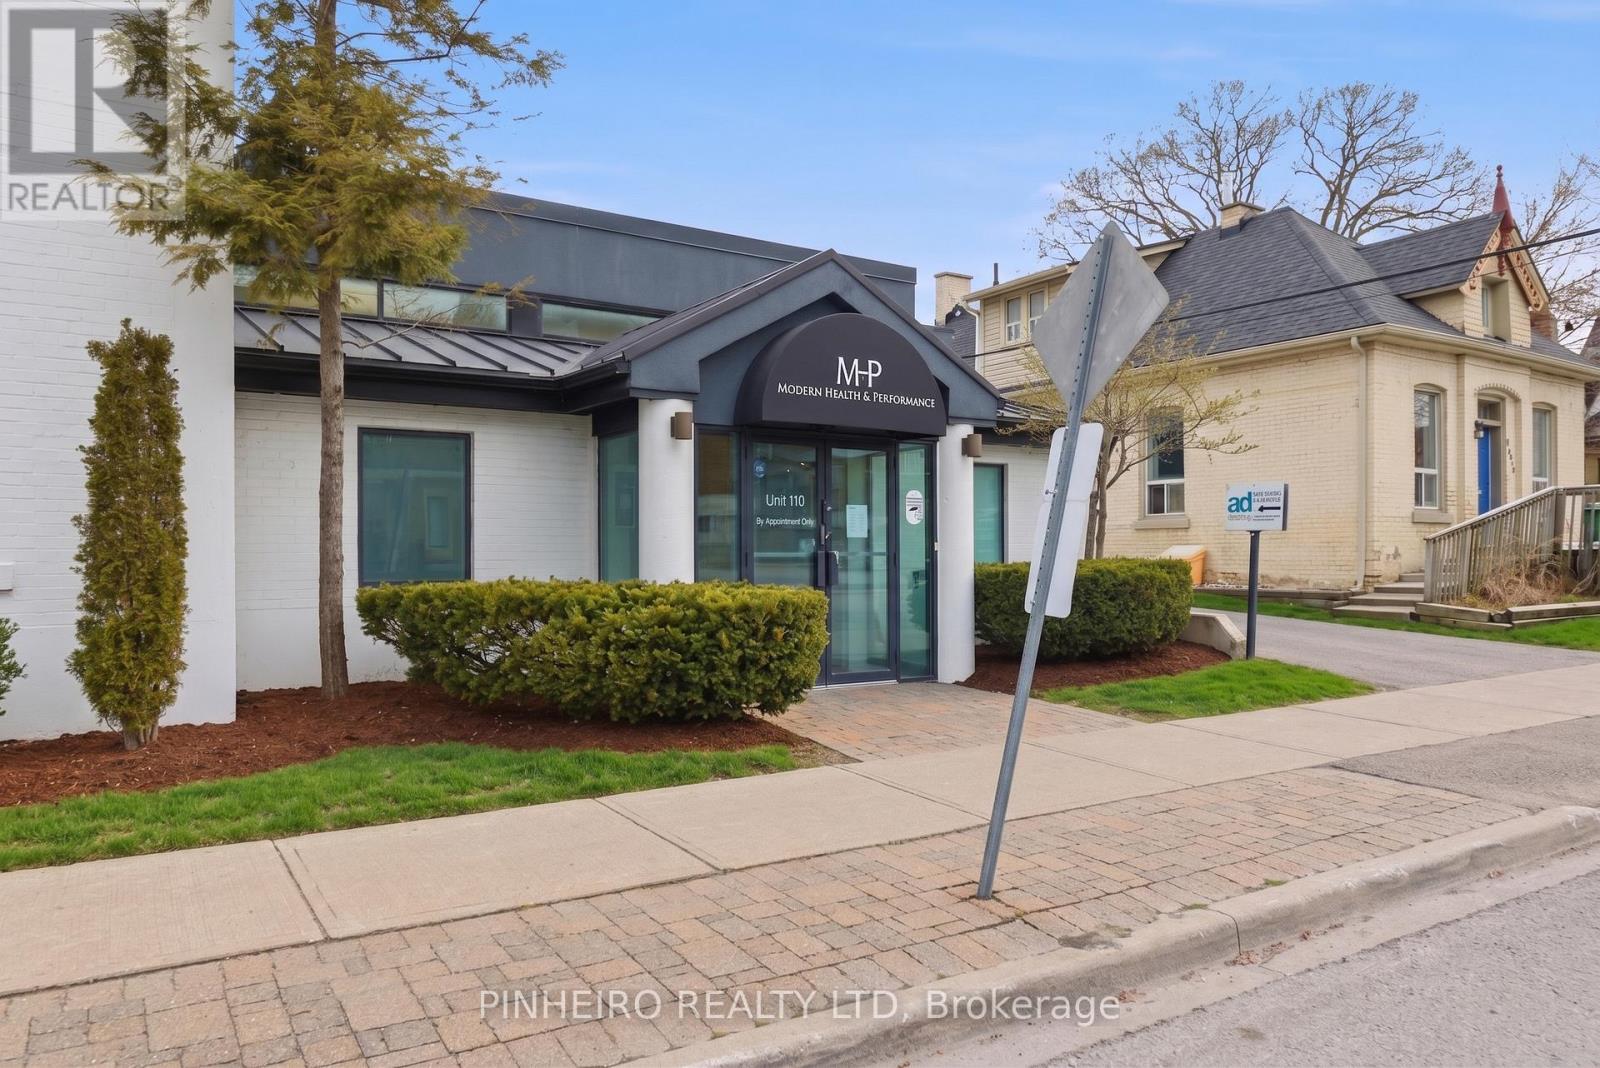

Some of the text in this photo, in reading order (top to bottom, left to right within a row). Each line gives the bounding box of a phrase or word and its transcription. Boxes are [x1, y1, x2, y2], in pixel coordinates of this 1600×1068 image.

[777, 382, 936, 408] MODERN HEALTH & PERFORMANCE
[765, 494, 805, 507] Unit 110
[1227, 491, 1252, 513] ad
[756, 517, 815, 527] By Appointment Only
